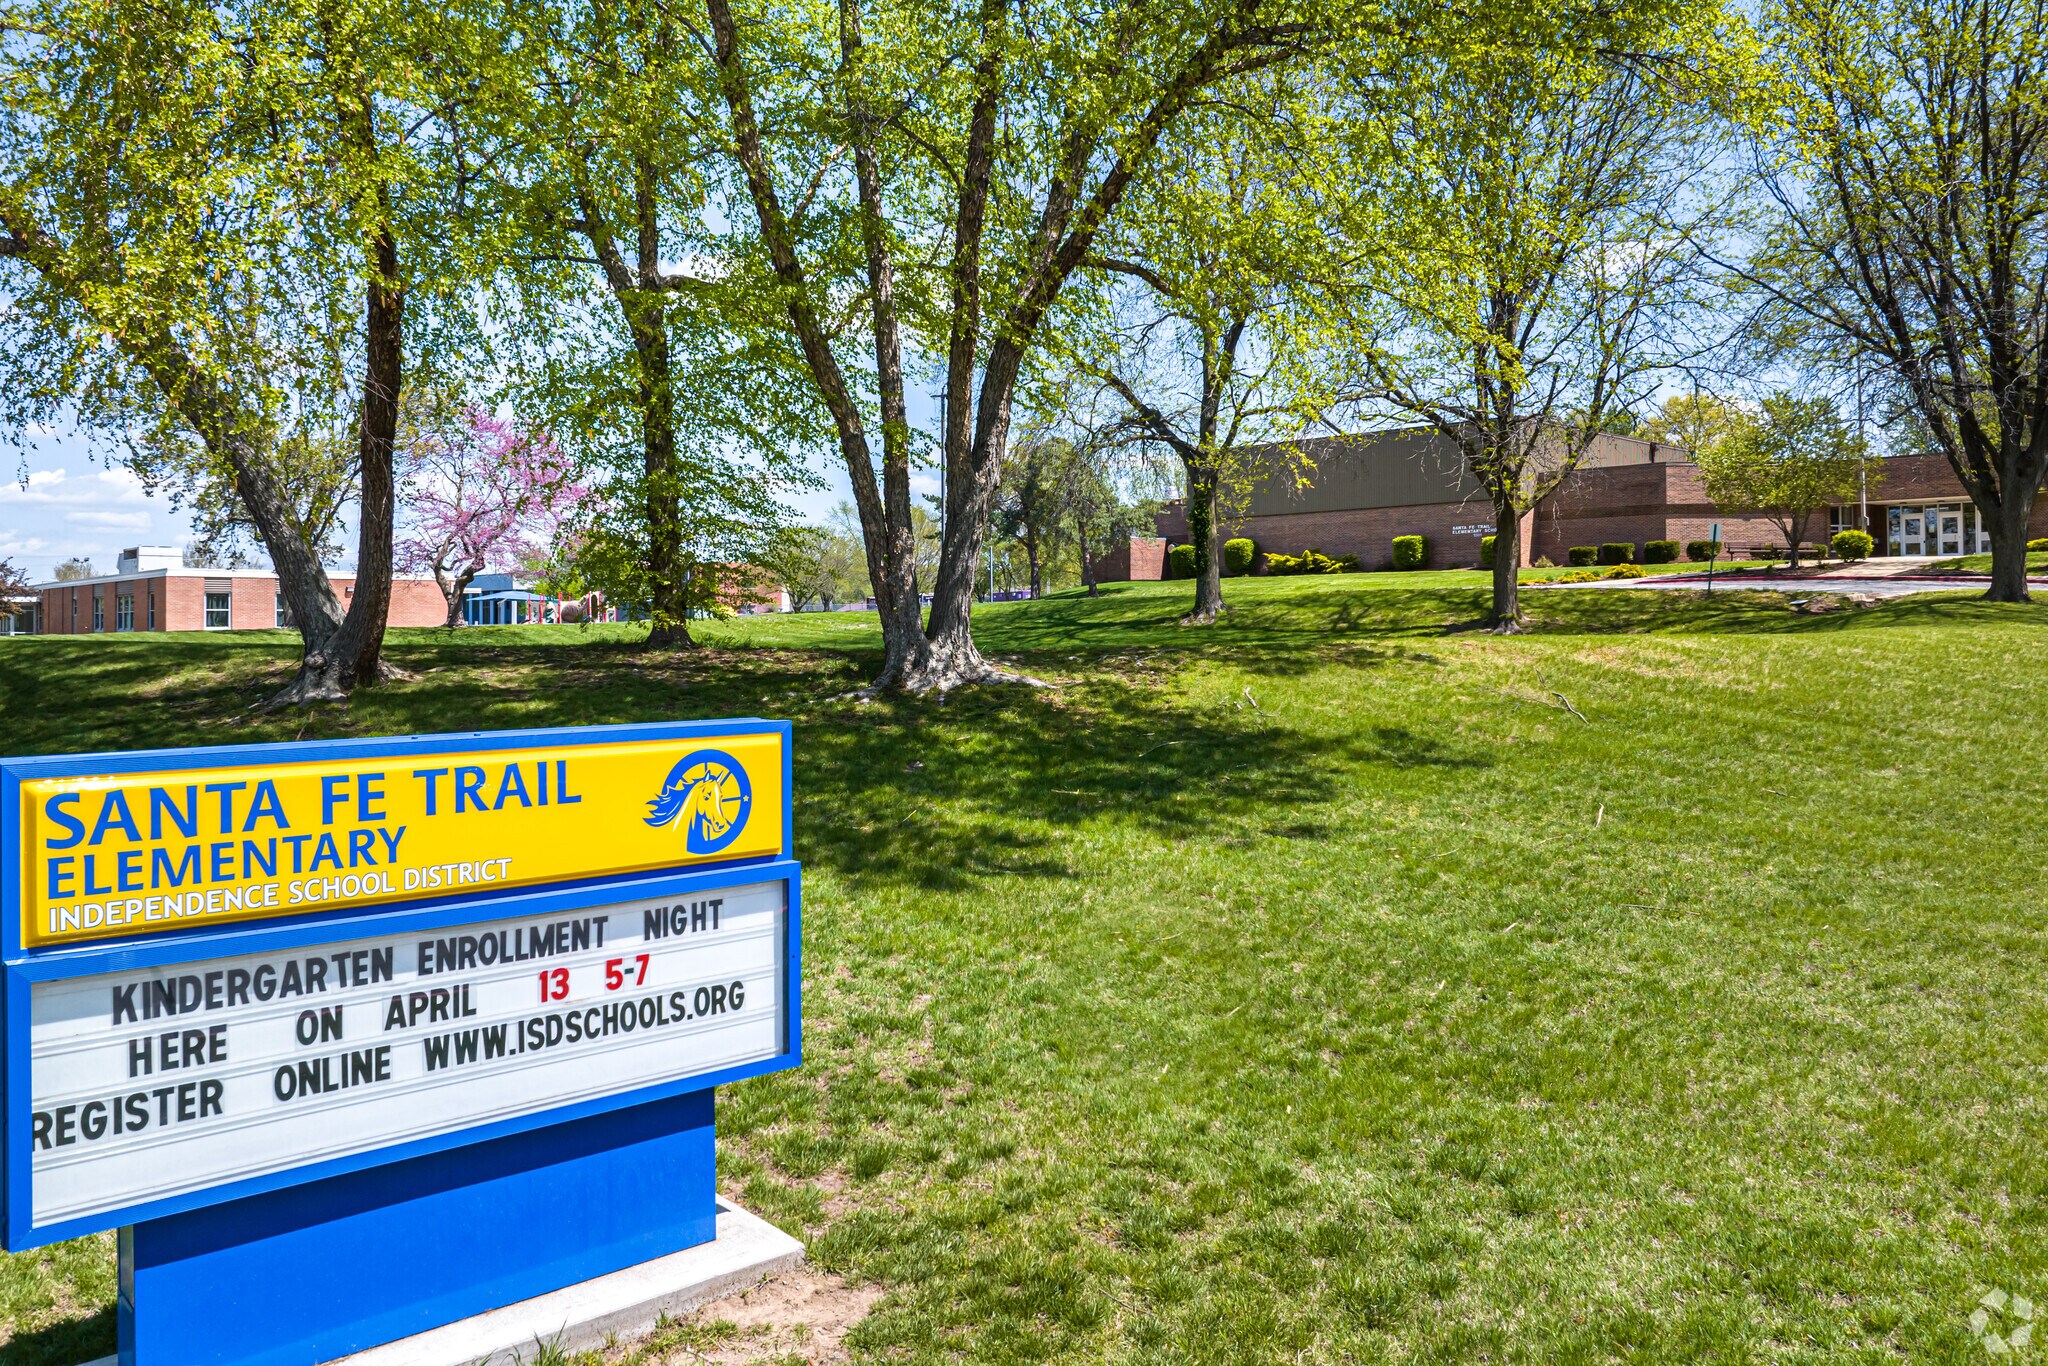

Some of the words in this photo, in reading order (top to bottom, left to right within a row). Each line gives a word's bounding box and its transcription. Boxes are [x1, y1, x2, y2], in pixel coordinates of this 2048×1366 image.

[45, 779, 291, 849] SANTA
[321, 772, 386, 825] FE
[413, 760, 582, 816] TRAIL
[47, 826, 407, 899] ELEMENTARY
[49, 883, 280, 933] INDEPENDENCE
[289, 869, 396, 904] SCHOOL
[404, 858, 513, 892] DISTRICT
[113, 946, 393, 1025] KINDERGARTEN
[418, 916, 608, 976] ENROLLMENT
[644, 899, 723, 941] NIGHT
[129, 1024, 228, 1078] HERE
[296, 1005, 343, 1046] ON
[384, 984, 477, 1031] APRIL
[539, 967, 570, 1002] 13
[605, 953, 650, 991] 5-7
[32, 1079, 224, 1152] REGISTER
[274, 1045, 391, 1101] ONLINE
[424, 981, 745, 1071] WWW.ISDSCHOOLS.ORG
